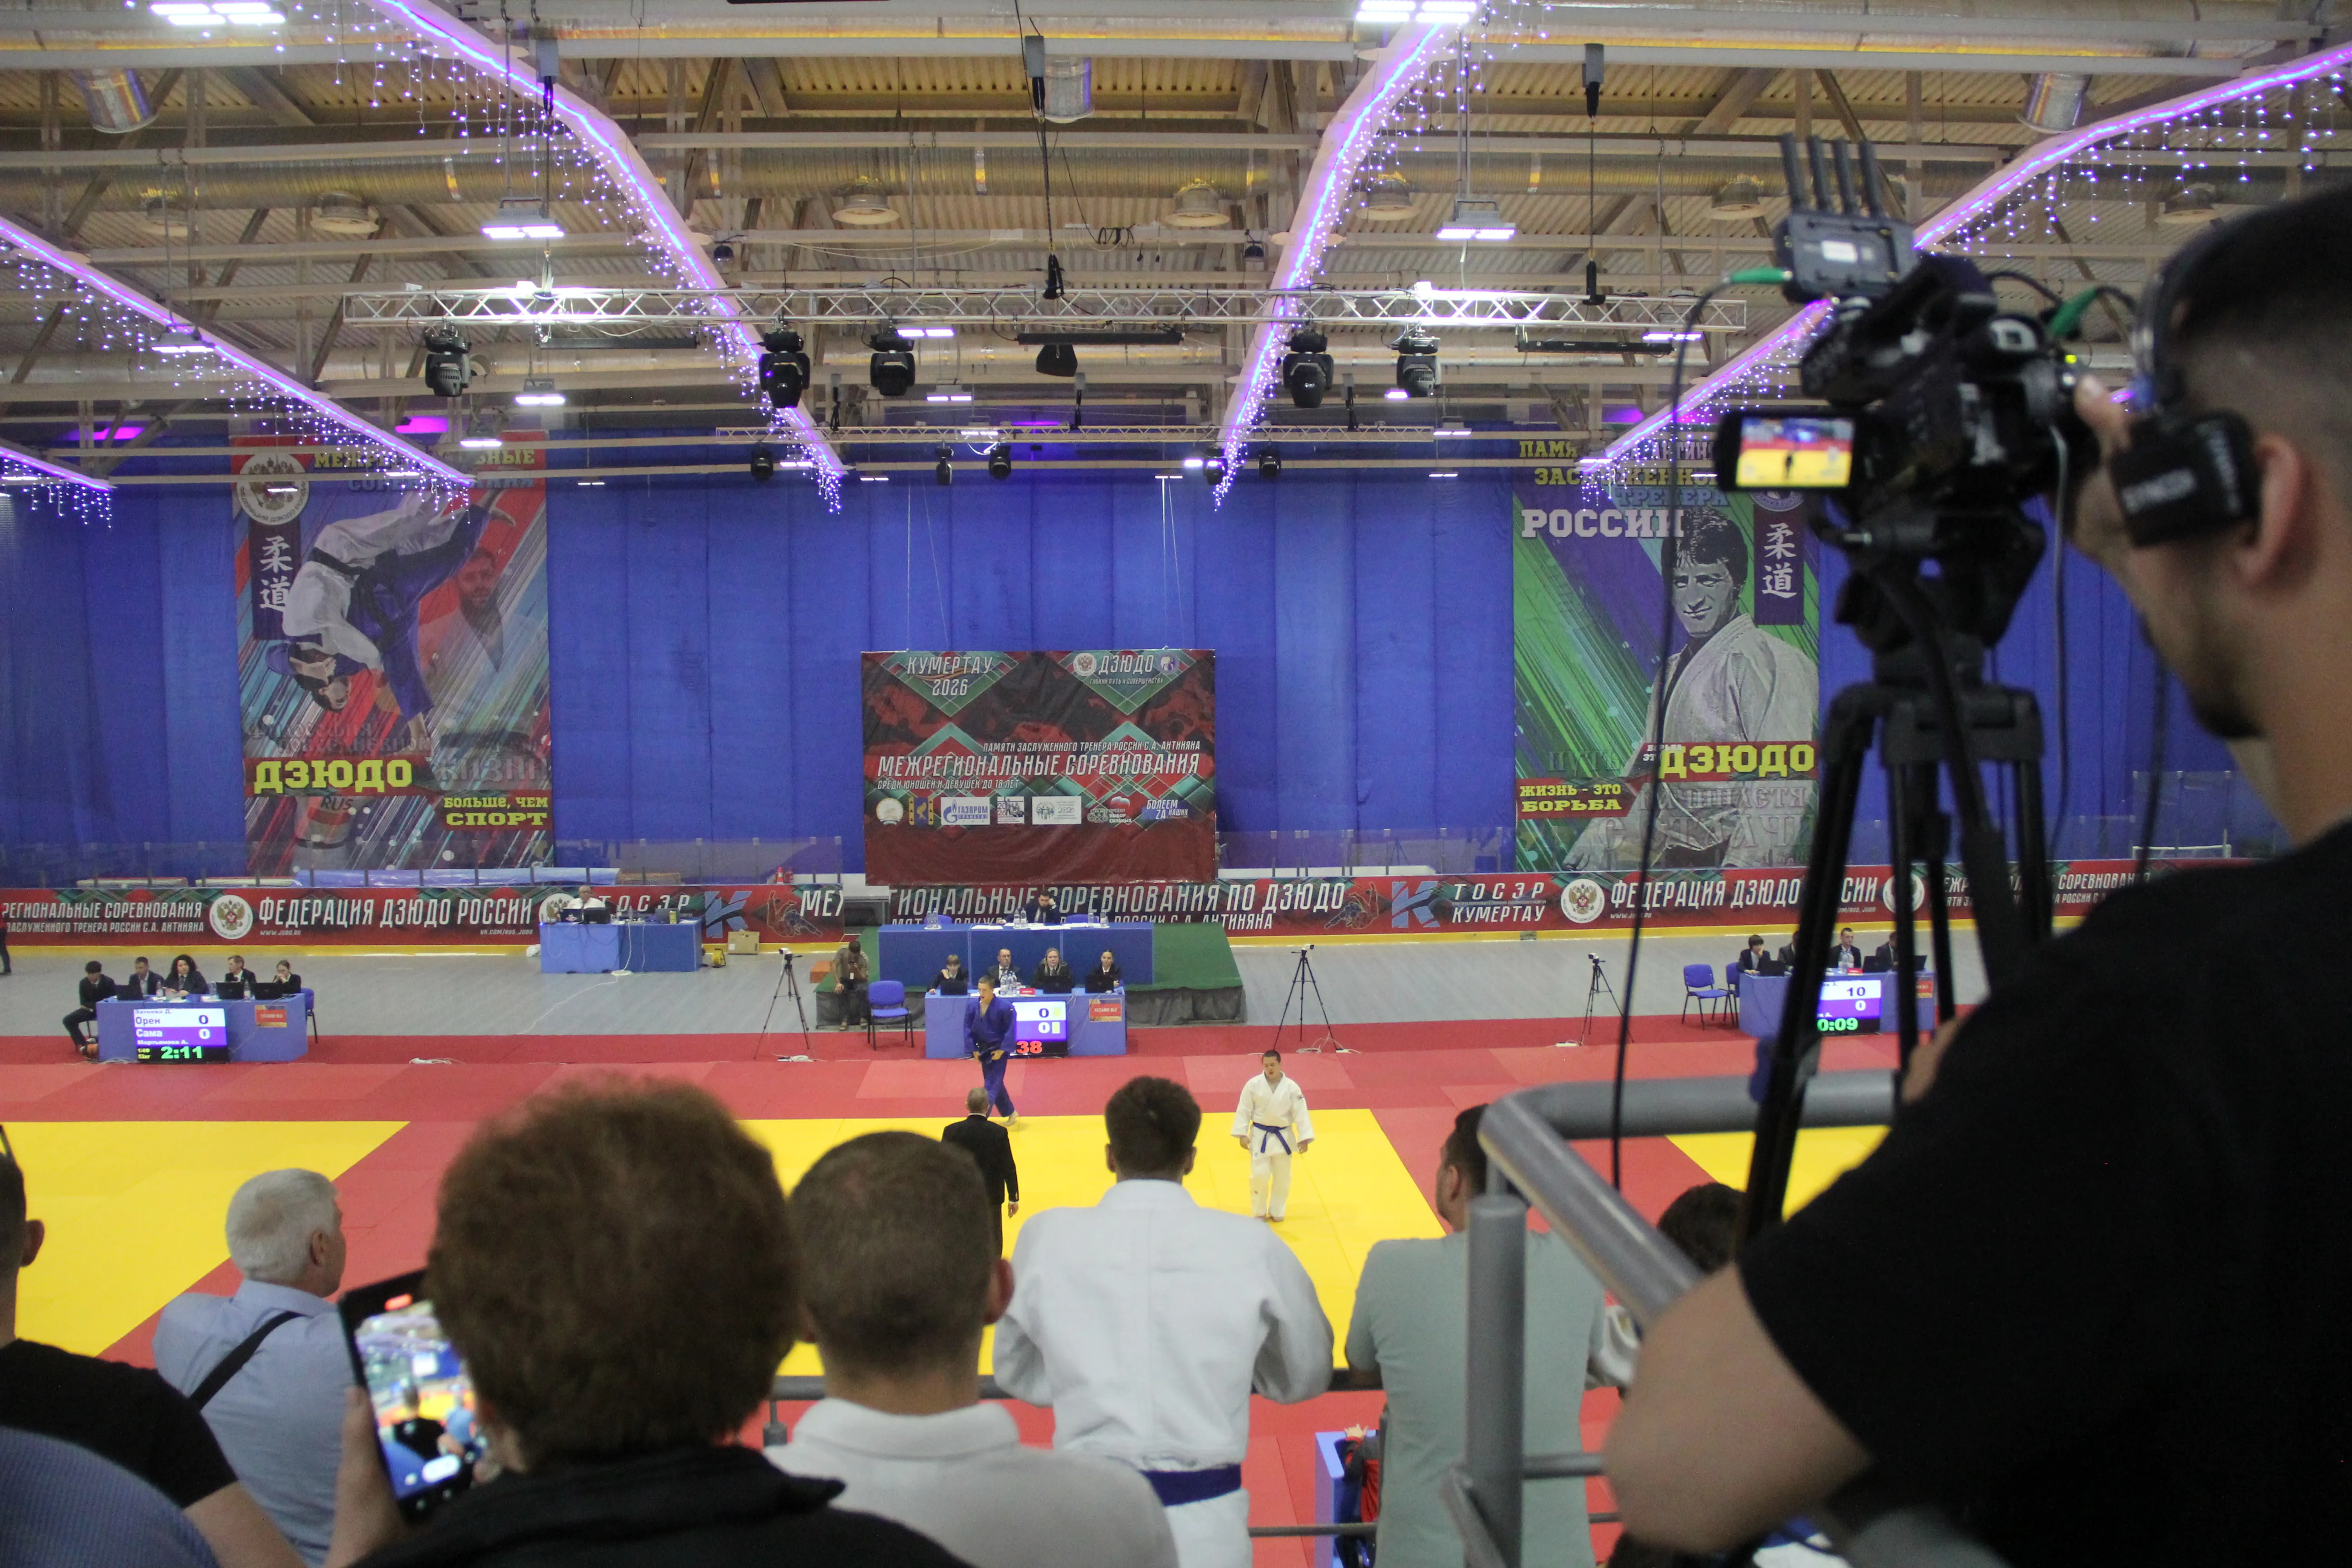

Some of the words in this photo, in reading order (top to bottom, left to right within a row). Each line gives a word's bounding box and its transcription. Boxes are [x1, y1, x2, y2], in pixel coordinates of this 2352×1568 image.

[1519, 440, 1577, 458] ПАМЯ
[1522, 509, 1684, 538] РОССИИ
[907, 656, 994, 675] КУМЕРТАУ
[1098, 655, 1154, 675] ДЗЮДО
[931, 678, 969, 696] 2026
[983, 743, 1016, 752] ПАМЯТИ
[1017, 742, 1078, 752] ЗАСЛУЖЕННОГО
[1080, 741, 1112, 751] ТРЕНЕРА
[1114, 741, 1142, 751] РОССИИ
[1161, 740, 1200, 750] АНТИНЯНА
[877, 755, 1060, 777] МЕЖРЕГИОНАЛЬНЫЕ
[1066, 753, 1200, 776] СОРЕВНОВАНИЯ
[1658, 744, 1814, 779] ДЗЮДО
[254, 760, 412, 794] ДЗЮДО
[877, 780, 902, 790] СРЕДИ
[938, 780, 942, 789] И
[944, 779, 980, 789] ДЕВУШЕК
[982, 779, 992, 789] ДО
[995, 779, 1002, 789] 18
[1004, 779, 1020, 789] ЛЕТ
[1519, 785, 1577, 797] ЖИЗНЬ
[1593, 784, 1621, 795] ЭТО
[515, 797, 548, 808] ЧЕМ
[1147, 799, 1179, 810] БОЛЕЕМ
[1522, 799, 1622, 813] БОРЬБА
[446, 812, 547, 825] СПОРТ
[1155, 809, 1166, 820] ZA
[1226, 884, 1256, 911] ПО
[1261, 882, 1345, 914] ДЗЮДО
[1454, 882, 1545, 901] ТОСЭР
[1610, 879, 1726, 909] ФЕДЕРАЦИЯ
[1730, 878, 1801, 909] ДЗЮДО
[1841, 877, 1878, 903] СИИ
[2062, 892, 2091, 904] РОССИИ
[104, 902, 202, 919] СОРЕВНОВАНИЯ
[259, 897, 374, 928] ФЕДЕРАЦИЯ
[380, 898, 451, 928] ДЗЮДО
[457, 898, 533, 924] РОССИИ
[1452, 906, 1545, 923] КУМЕРТАУ
[7, 921, 71, 933] ЗАСЛУЖЕННОГО
[74, 921, 108, 933] ТРЕНЕРА
[109, 921, 142, 933] РОССИИ
[161, 921, 204, 932] АНТИНЯНА
[1847, 987, 1866, 997] 10
[1855, 1000, 1866, 1011] 0
[135, 1017, 161, 1026] Орен
[199, 1014, 209, 1024] 0
[1039, 1008, 1049, 1018] 0
[1038, 1022, 1050, 1034] 0
[1817, 1017, 1859, 1032] 0:09
[136, 1029, 163, 1037] Сама
[199, 1028, 211, 1039] 0
[161, 1046, 202, 1059] 2:11
[1016, 1040, 1042, 1054] 38
